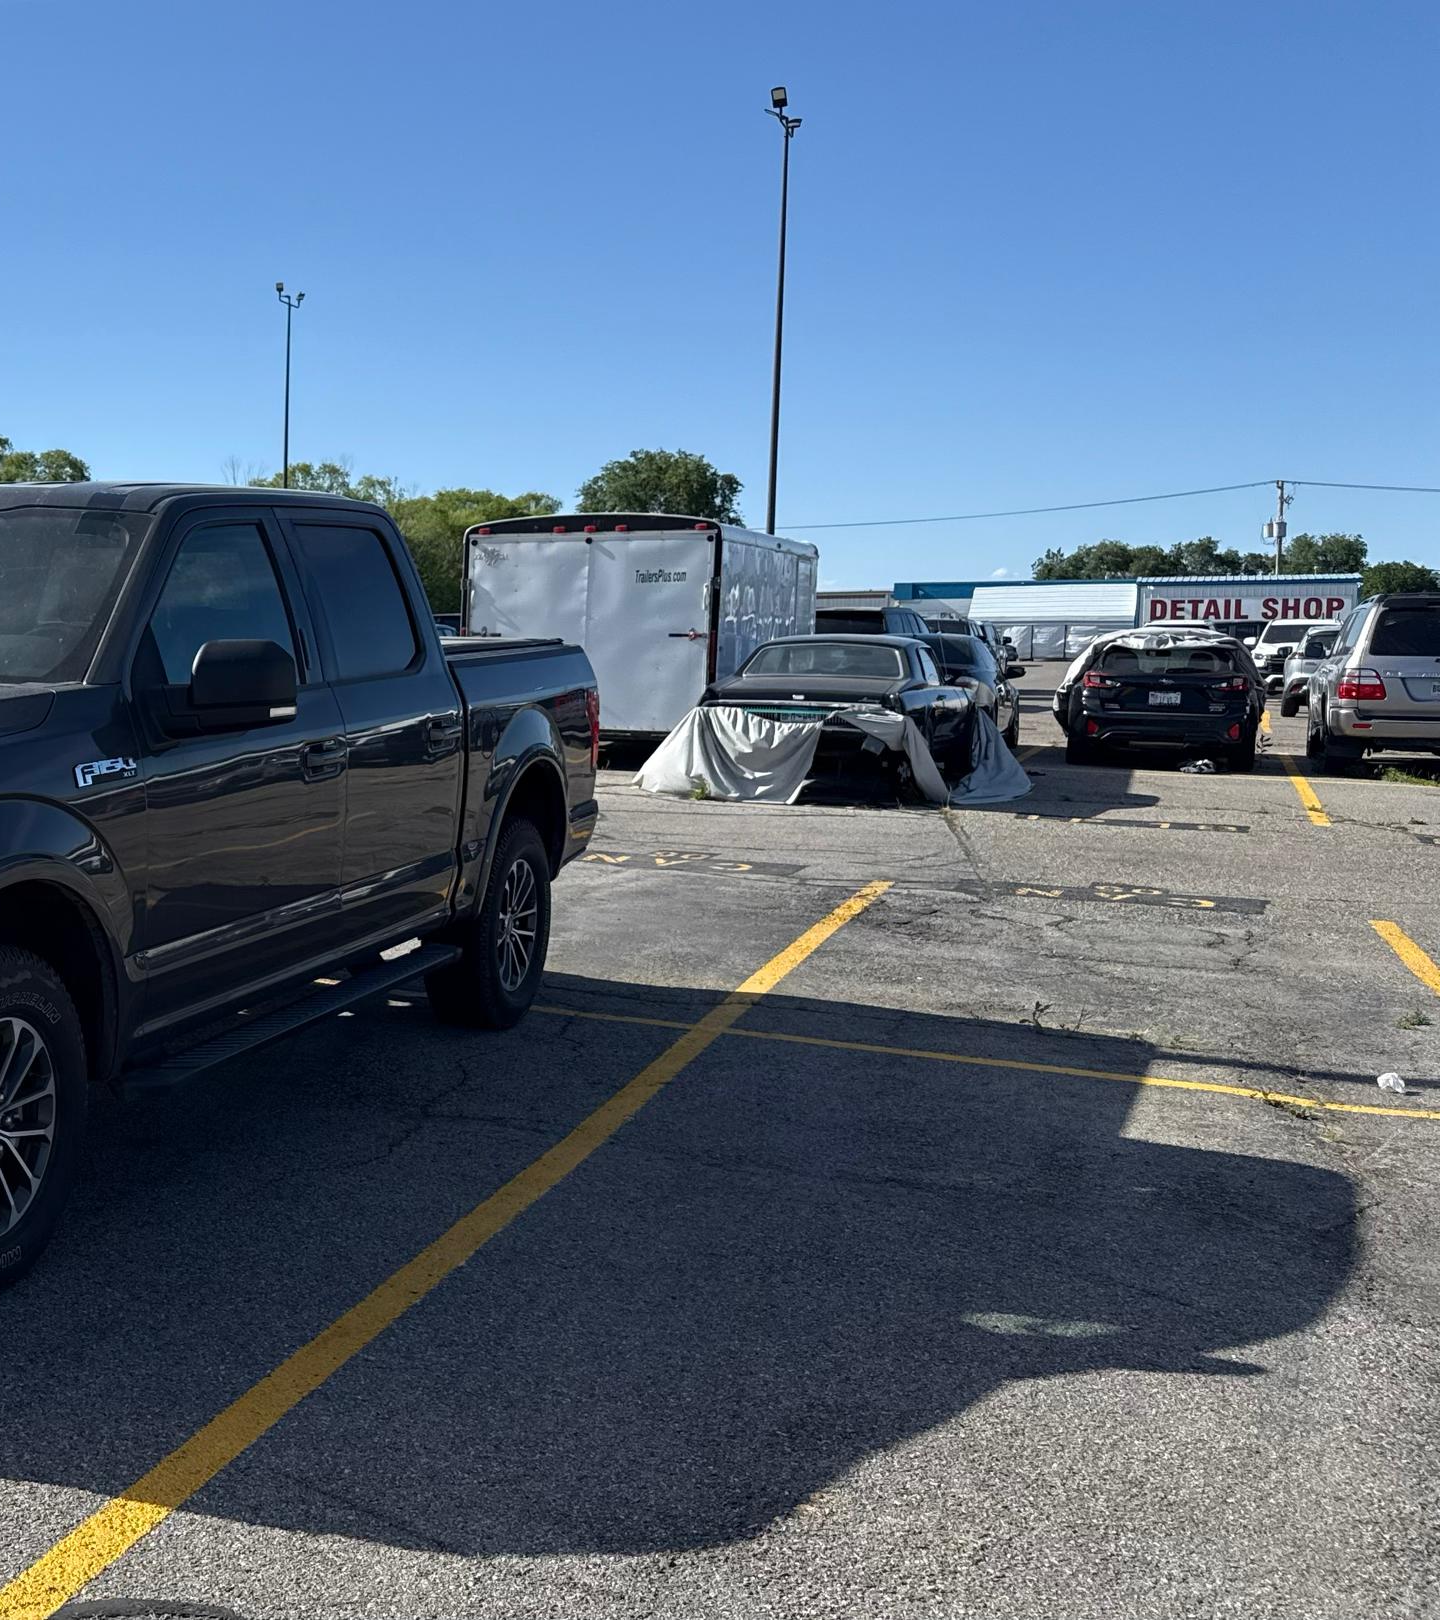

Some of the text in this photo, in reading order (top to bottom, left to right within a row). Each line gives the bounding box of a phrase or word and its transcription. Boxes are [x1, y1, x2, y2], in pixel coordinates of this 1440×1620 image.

[635, 568, 687, 583] TrailersPlus.com
[1150, 597, 1345, 620] DETAIL SHOP
[122, 770, 136, 778] XLT
